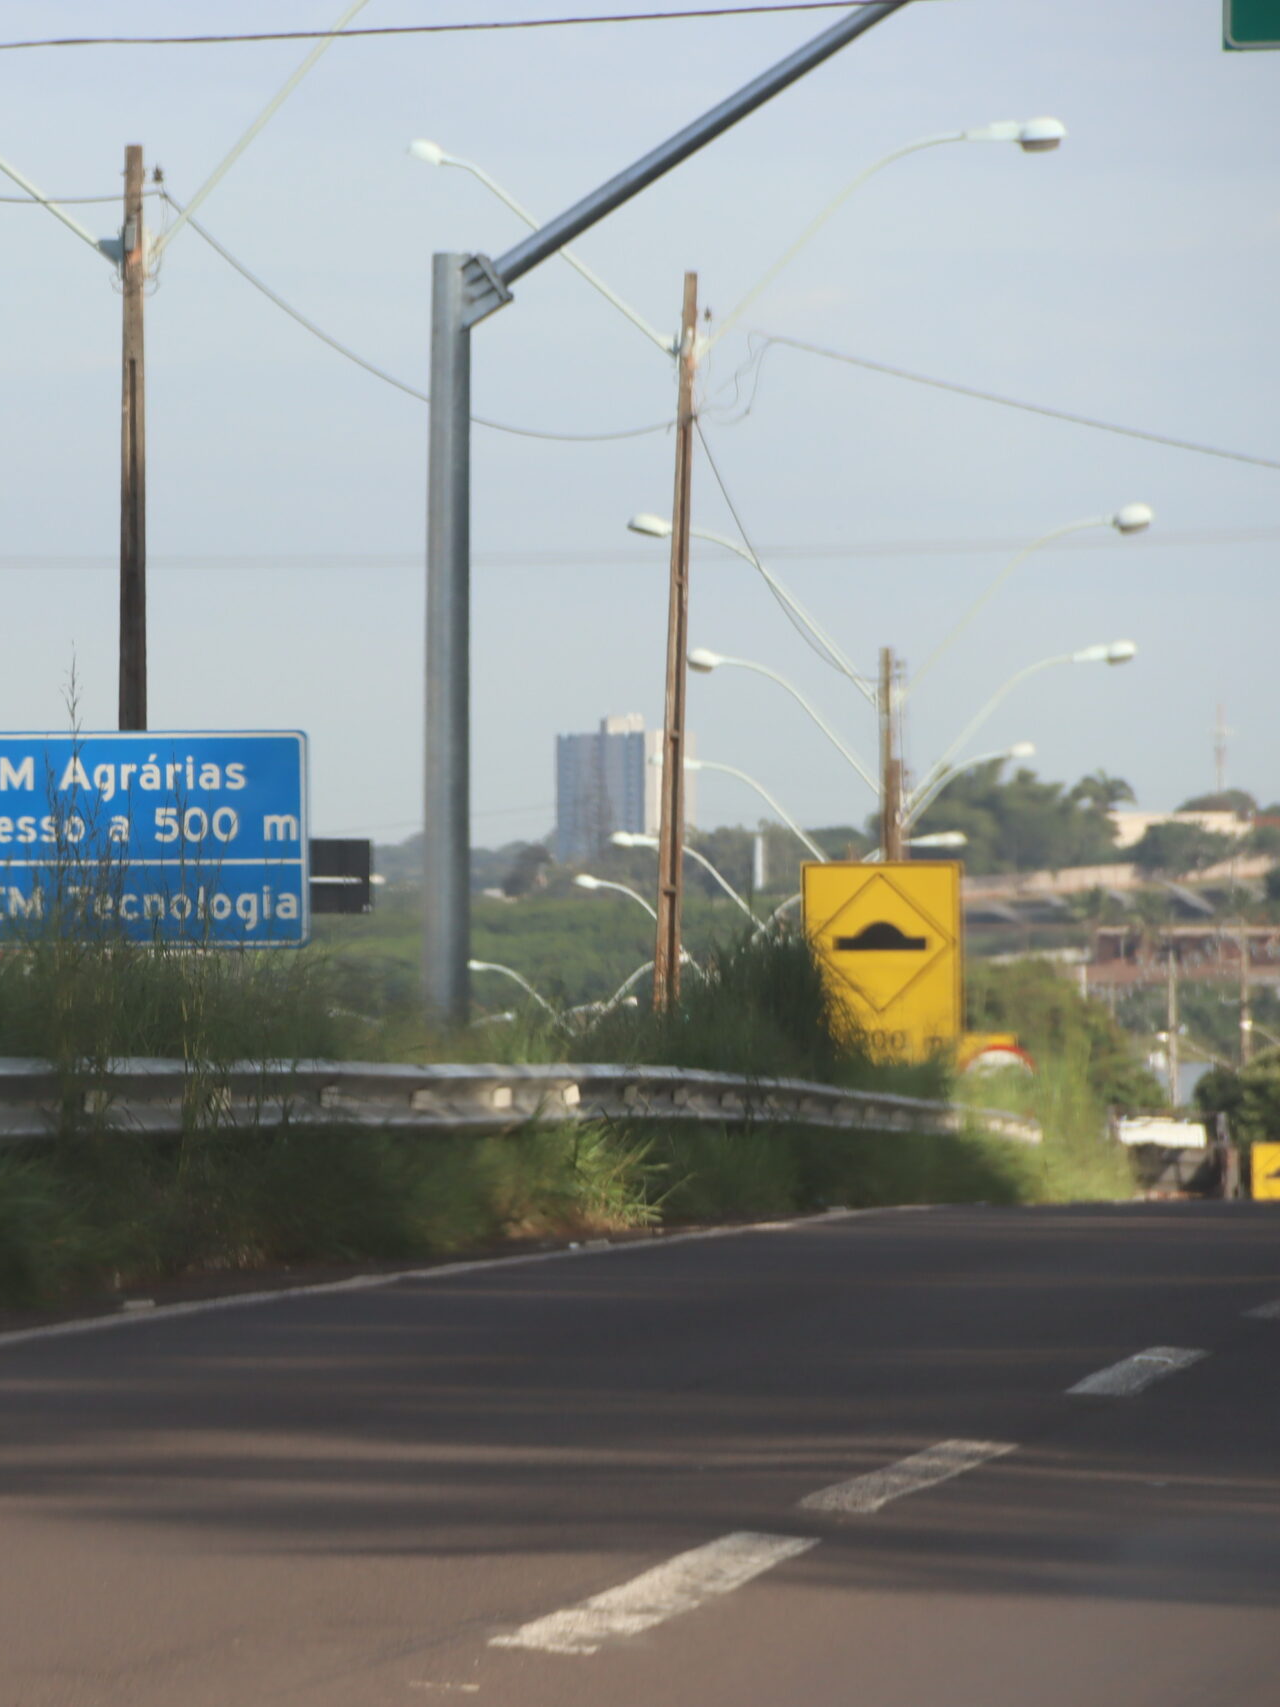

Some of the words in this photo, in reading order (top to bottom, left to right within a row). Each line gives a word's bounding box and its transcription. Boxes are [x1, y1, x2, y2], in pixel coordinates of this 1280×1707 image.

[58, 753, 247, 802] Agrárias
[109, 815, 130, 842] a
[154, 806, 239, 843] 500
[263, 813, 298, 841] m
